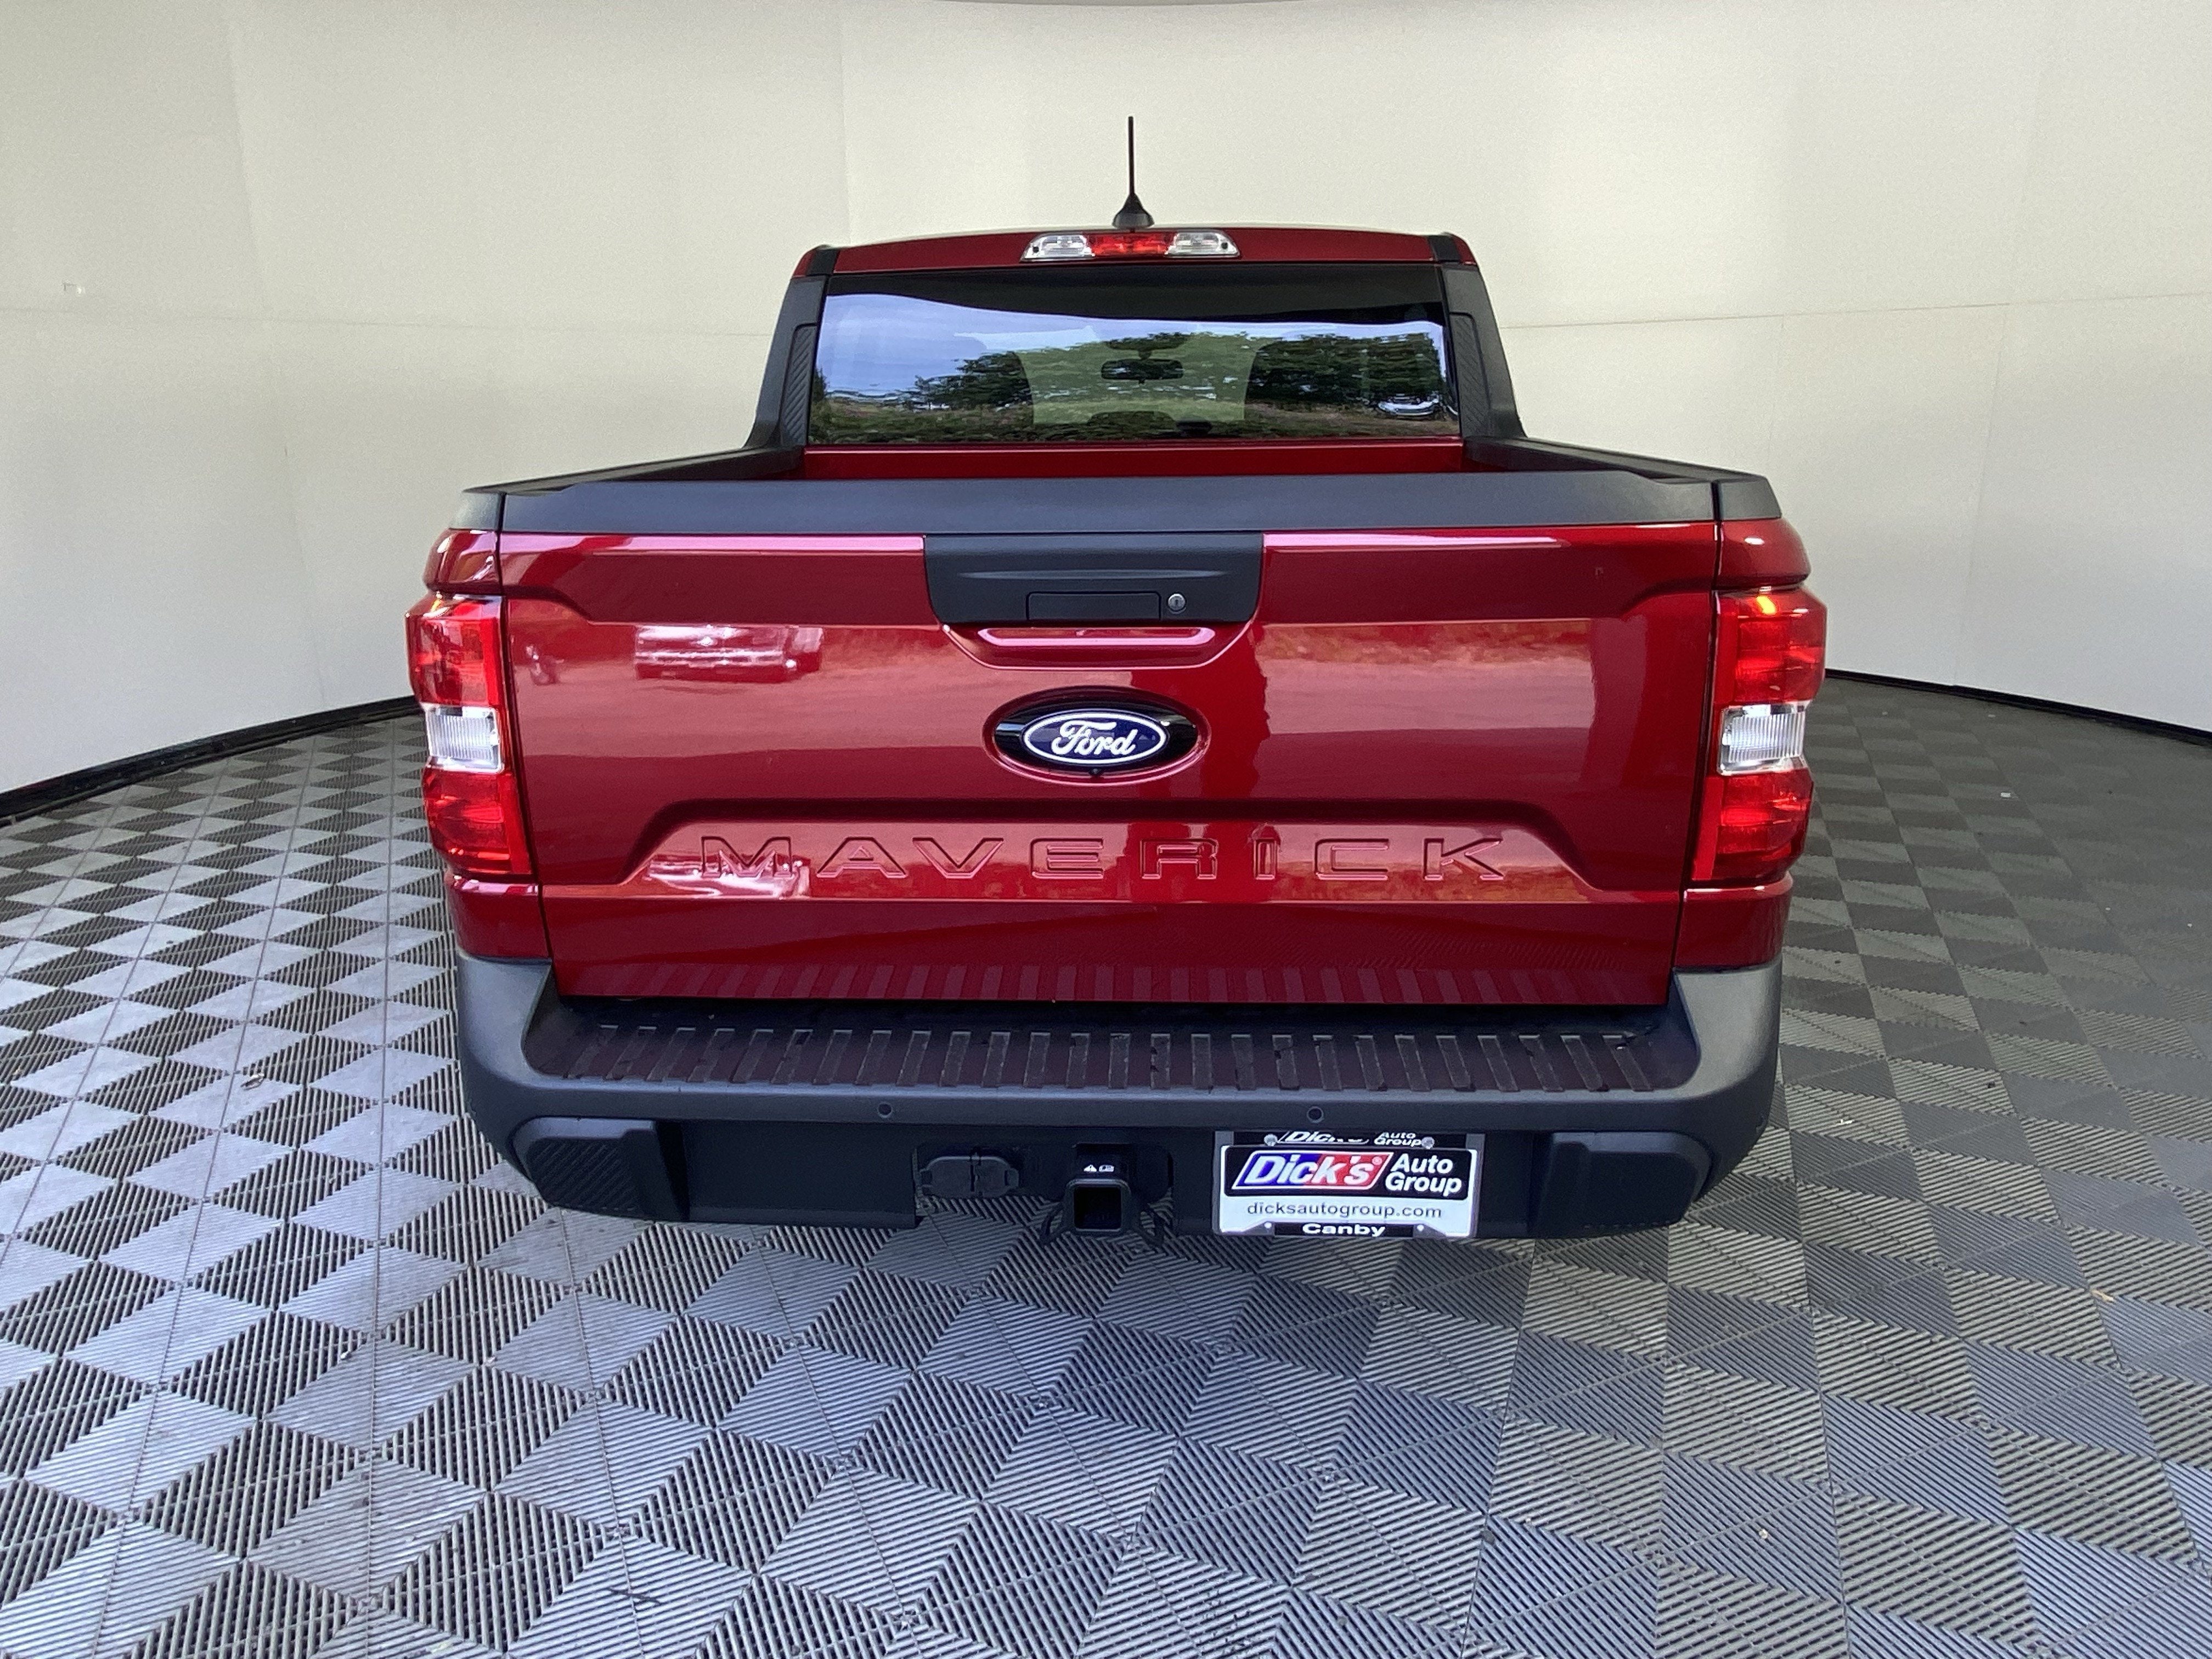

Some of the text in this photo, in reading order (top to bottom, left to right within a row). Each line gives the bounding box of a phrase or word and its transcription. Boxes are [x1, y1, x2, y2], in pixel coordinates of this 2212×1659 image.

[1051, 720, 1139, 755] Ford
[701, 836, 1504, 879] MAVERICK
[1374, 1138, 1422, 1147] Group
[1244, 1154, 1374, 1186] Dick's
[1391, 1153, 1453, 1173] Auto
[1385, 1172, 1462, 1197] Group
[1248, 1201, 1442, 1218] dicksautogroup.com
[1302, 1223, 1386, 1237] Canby
